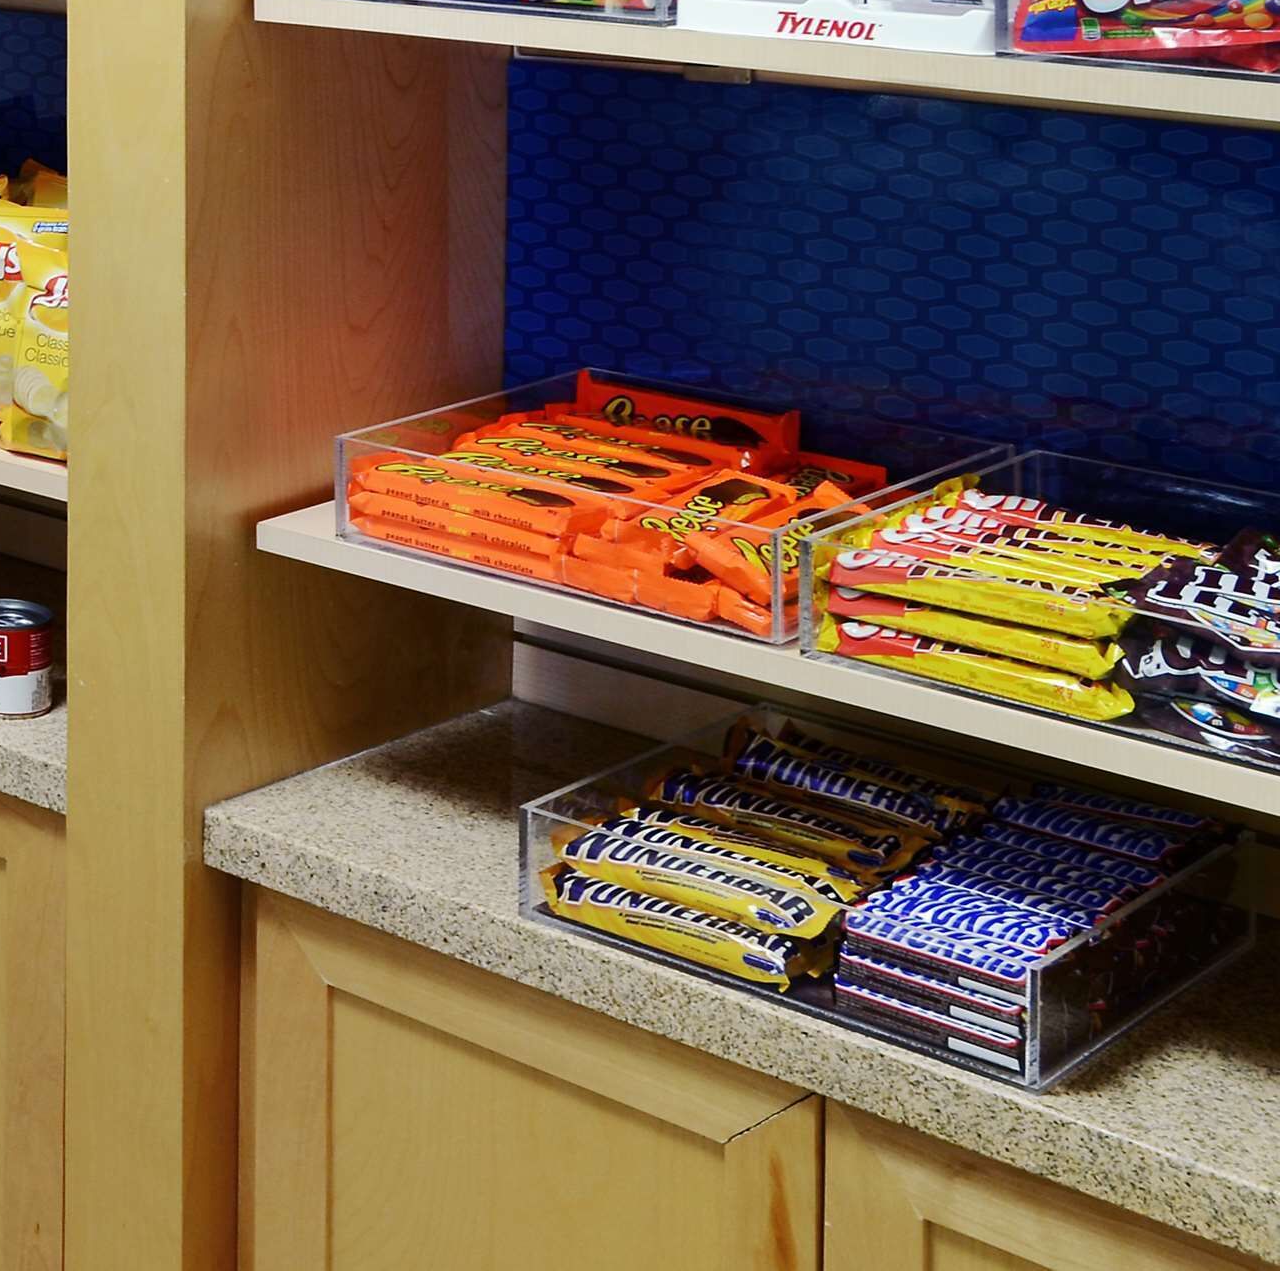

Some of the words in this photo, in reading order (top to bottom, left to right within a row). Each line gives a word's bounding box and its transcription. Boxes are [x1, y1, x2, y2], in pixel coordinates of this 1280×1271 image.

[776, 11, 876, 41] TYLENOL
[24, 347, 69, 367] Classi
[35, 333, 69, 351] Class
[385, 487, 412, 498] peanut
[413, 493, 440, 507] butter
[442, 498, 451, 508] in
[472, 504, 489, 517] milk
[489, 511, 534, 529] chocolate
[380, 508, 408, 521] peanut
[410, 514, 436, 528] butter
[438, 521, 447, 530] in
[471, 527, 488, 540] milk
[488, 534, 532, 552] chocolate
[385, 531, 412, 543] peanut
[414, 537, 440, 551] butter
[441, 544, 451, 554] in
[474, 552, 491, 564] milk
[493, 558, 534, 576] chocolate
[991, 795, 1173, 862] SNICKERS
[561, 829, 818, 926] WUNDERBAR
